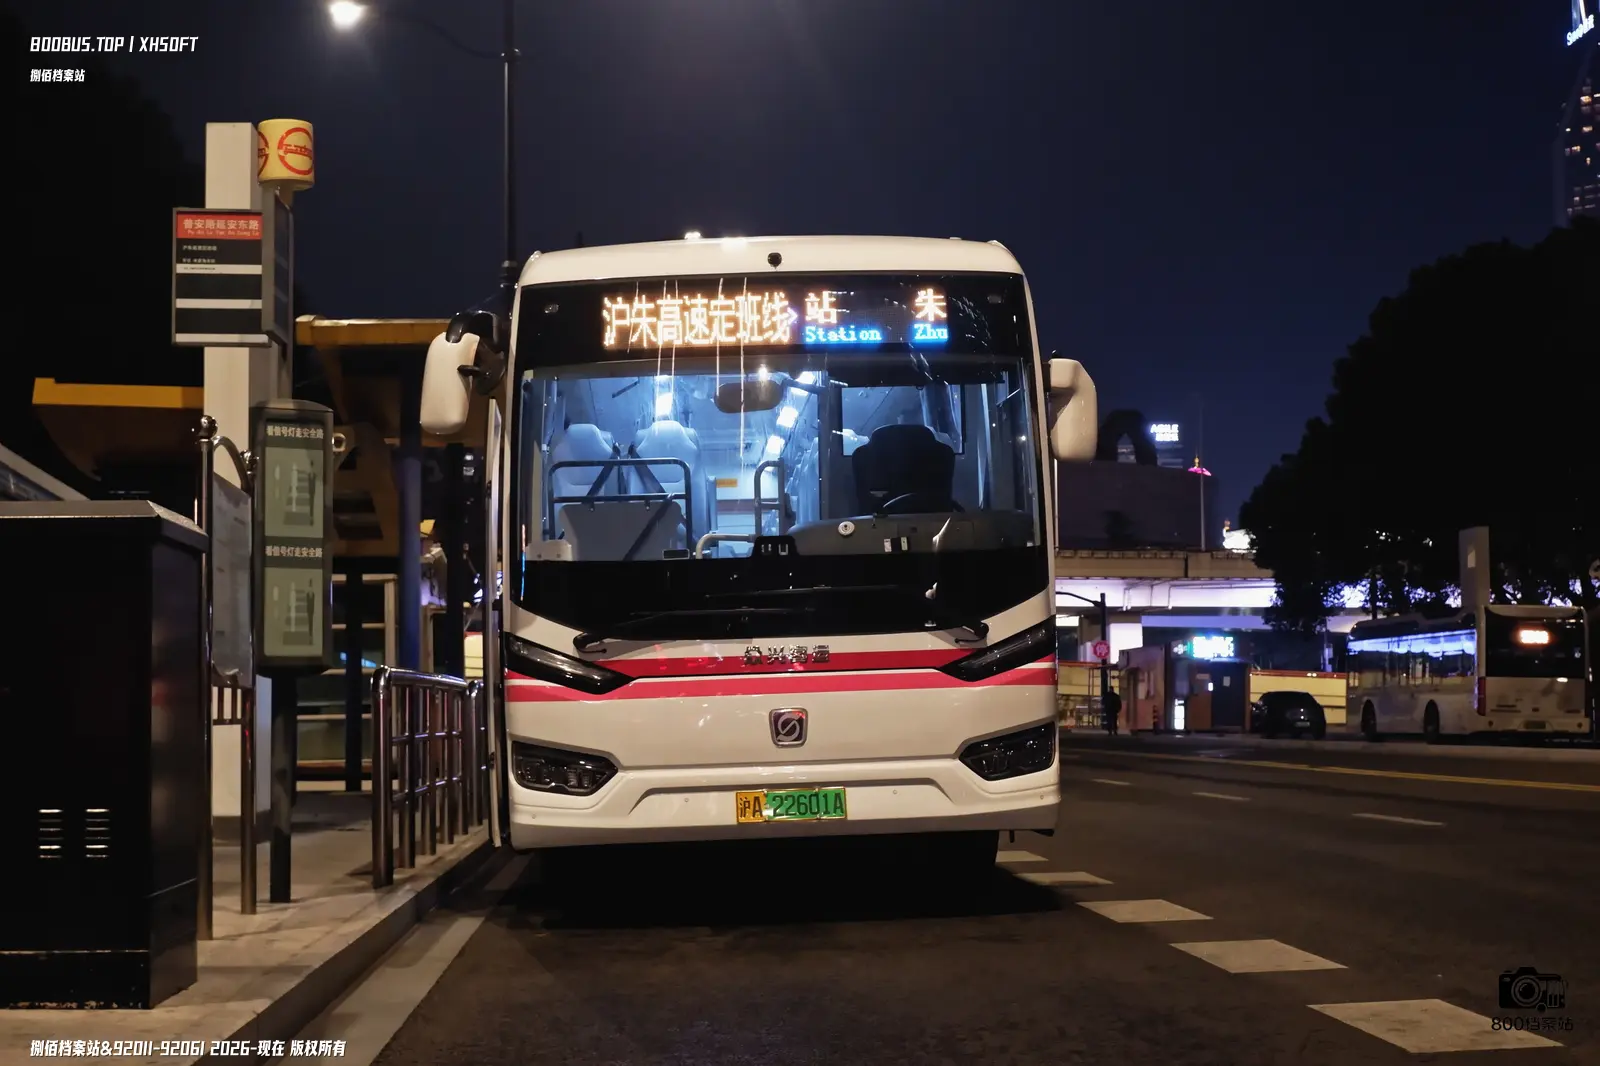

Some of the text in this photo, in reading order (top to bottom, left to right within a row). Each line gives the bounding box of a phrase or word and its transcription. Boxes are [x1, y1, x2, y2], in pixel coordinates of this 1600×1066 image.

[183, 219, 259, 230] 普安路延安东路
[603, 288, 947, 347] 沪朱高速定班线 站 朱
[804, 323, 949, 342] Station Zhu
[739, 792, 845, 818] 沪A 22601A
